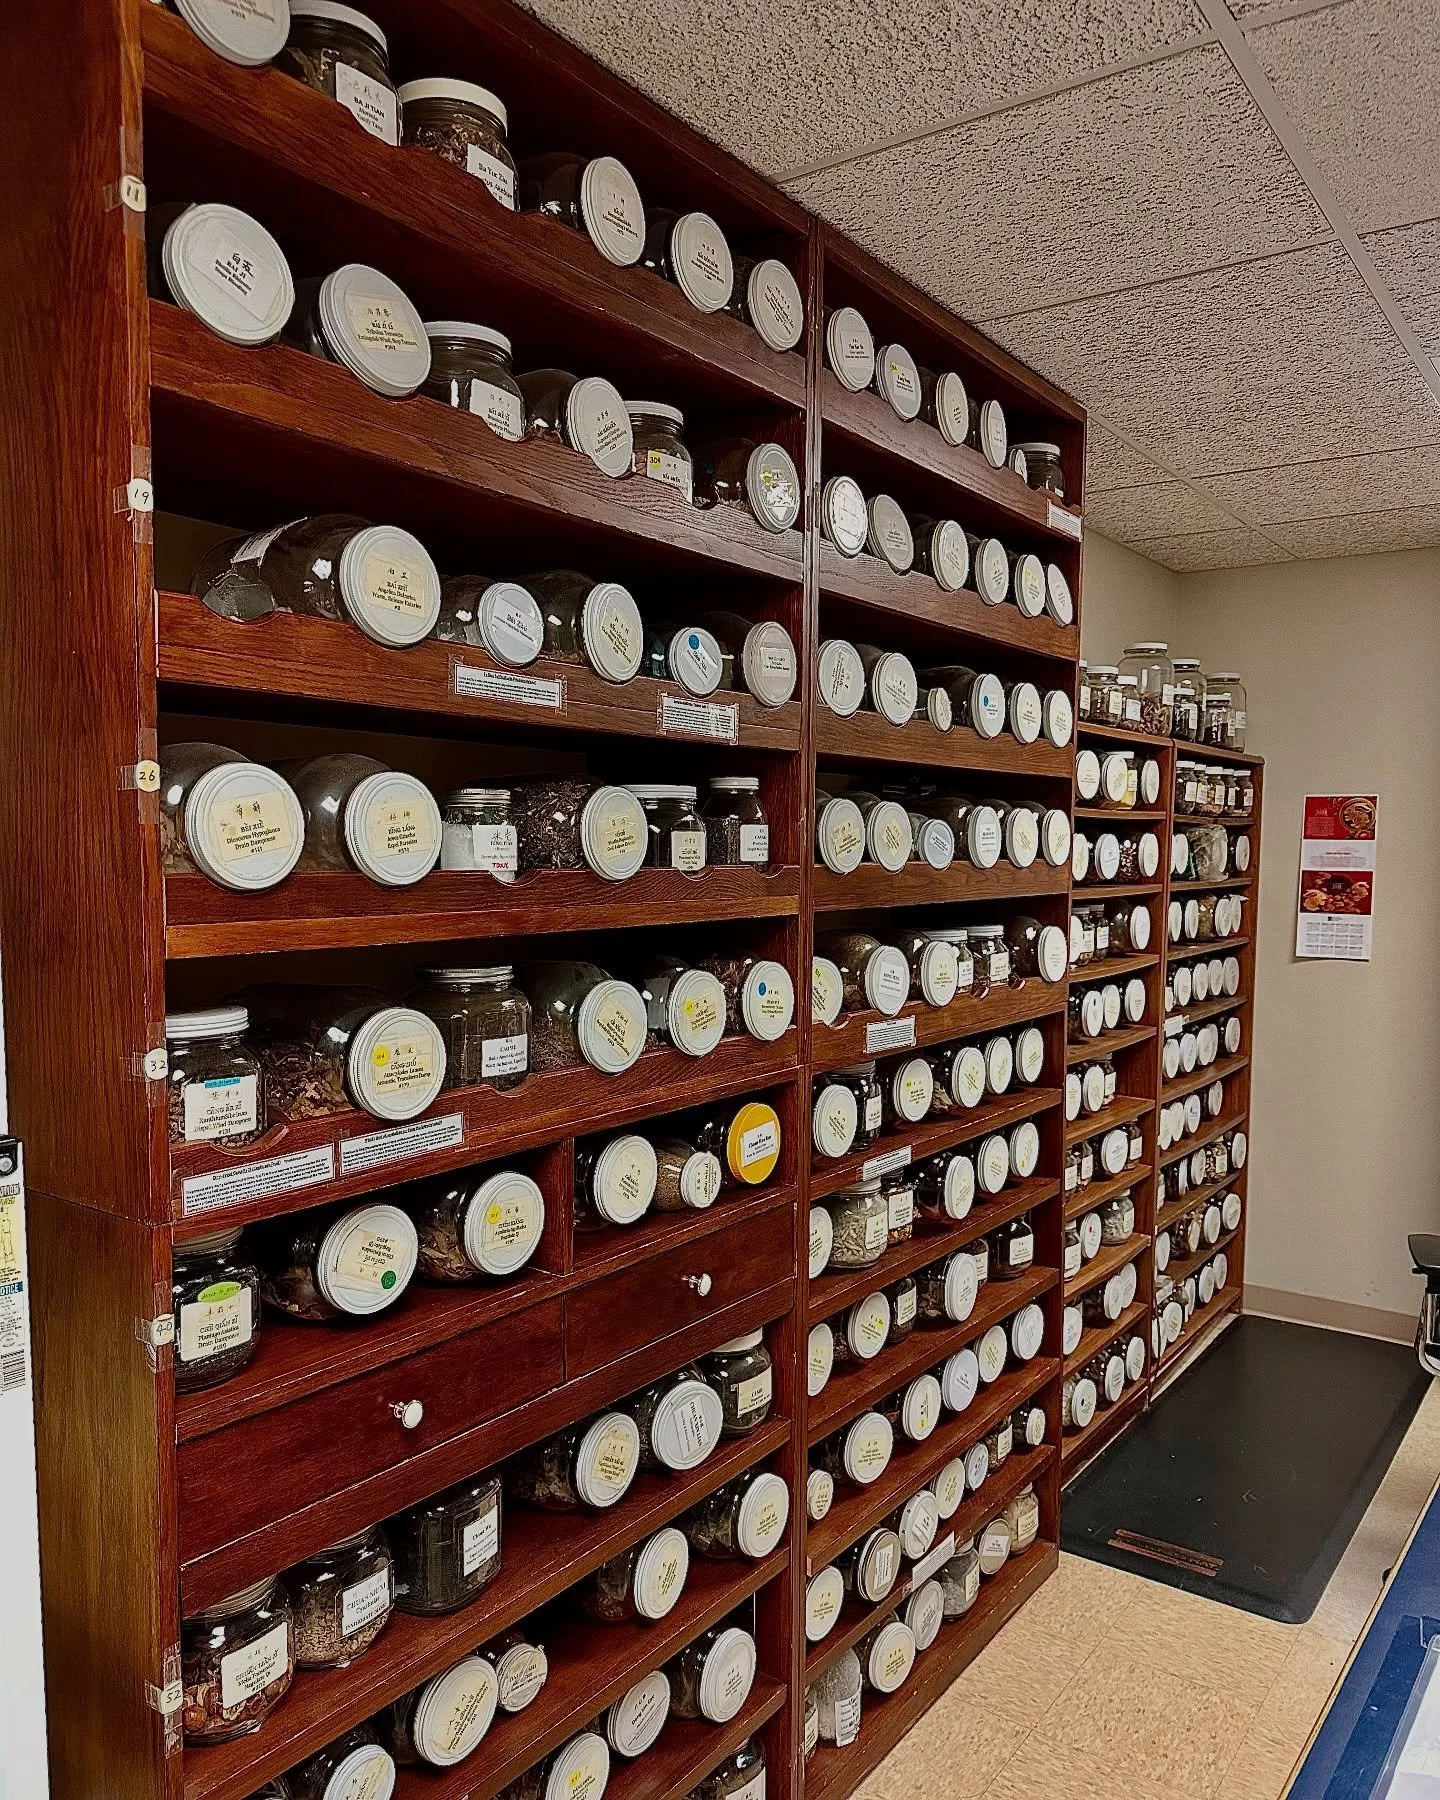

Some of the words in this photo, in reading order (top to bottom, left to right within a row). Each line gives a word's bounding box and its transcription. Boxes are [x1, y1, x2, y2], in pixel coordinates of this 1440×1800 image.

[134, 488, 150, 505] 19
[139, 769, 156, 782] 26
[0, 1282, 18, 1296] OTICE
[157, 1321, 173, 1336] 40
[166, 1689, 182, 1704] 52
